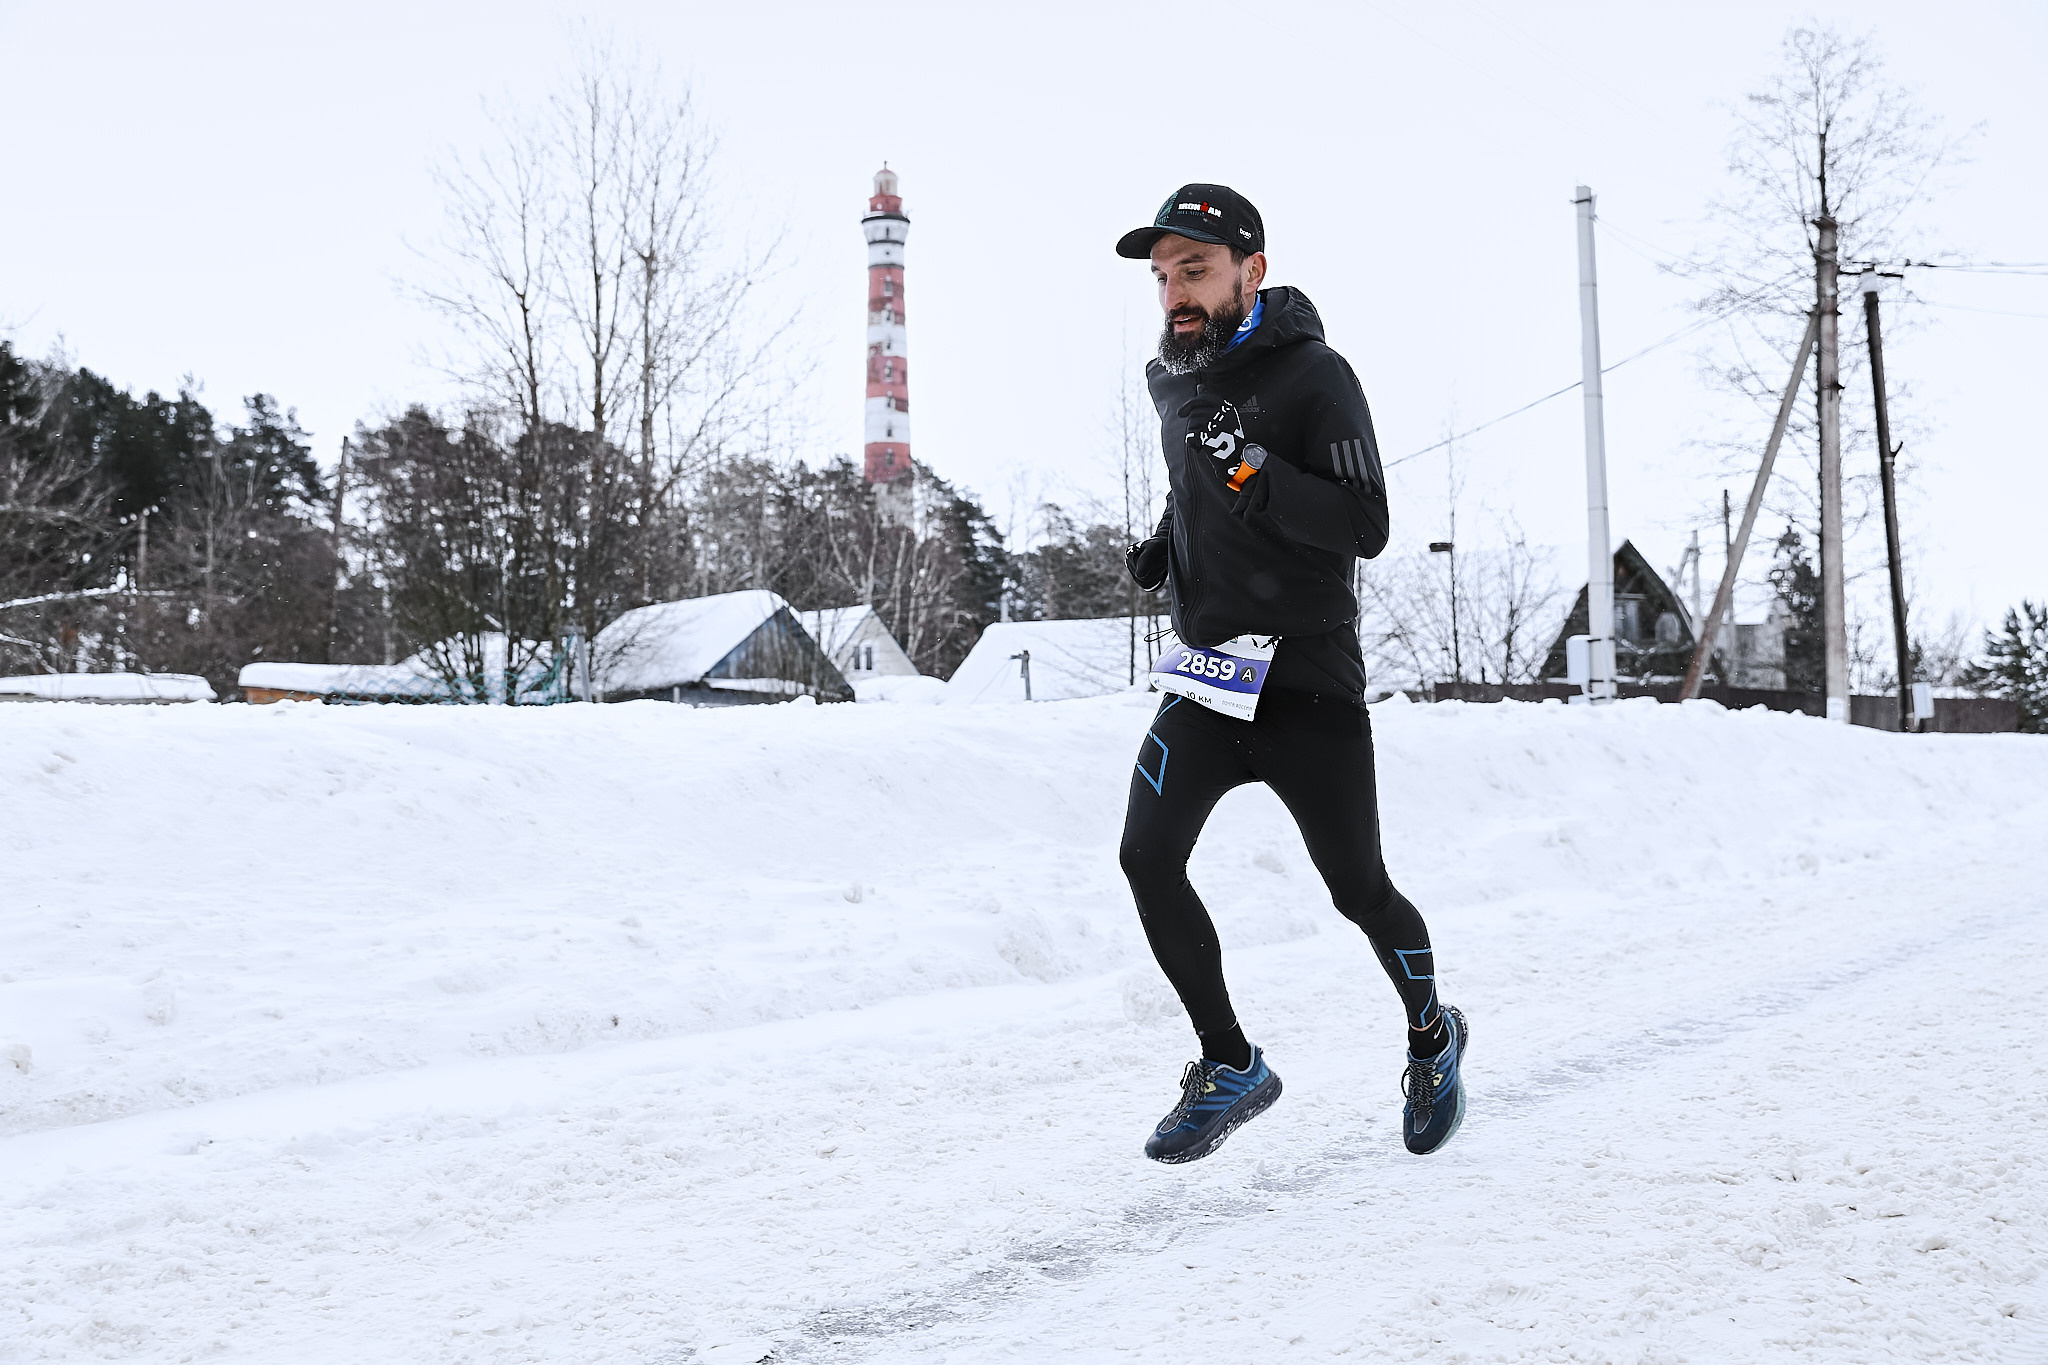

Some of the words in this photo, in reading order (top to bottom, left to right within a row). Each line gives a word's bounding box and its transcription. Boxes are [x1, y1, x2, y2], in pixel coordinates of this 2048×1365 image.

[1178, 202, 1222, 217] IRONMAN
[1176, 651, 1236, 681] 2859
[1241, 668, 1253, 682] A
[1185, 690, 1196, 700] 10
